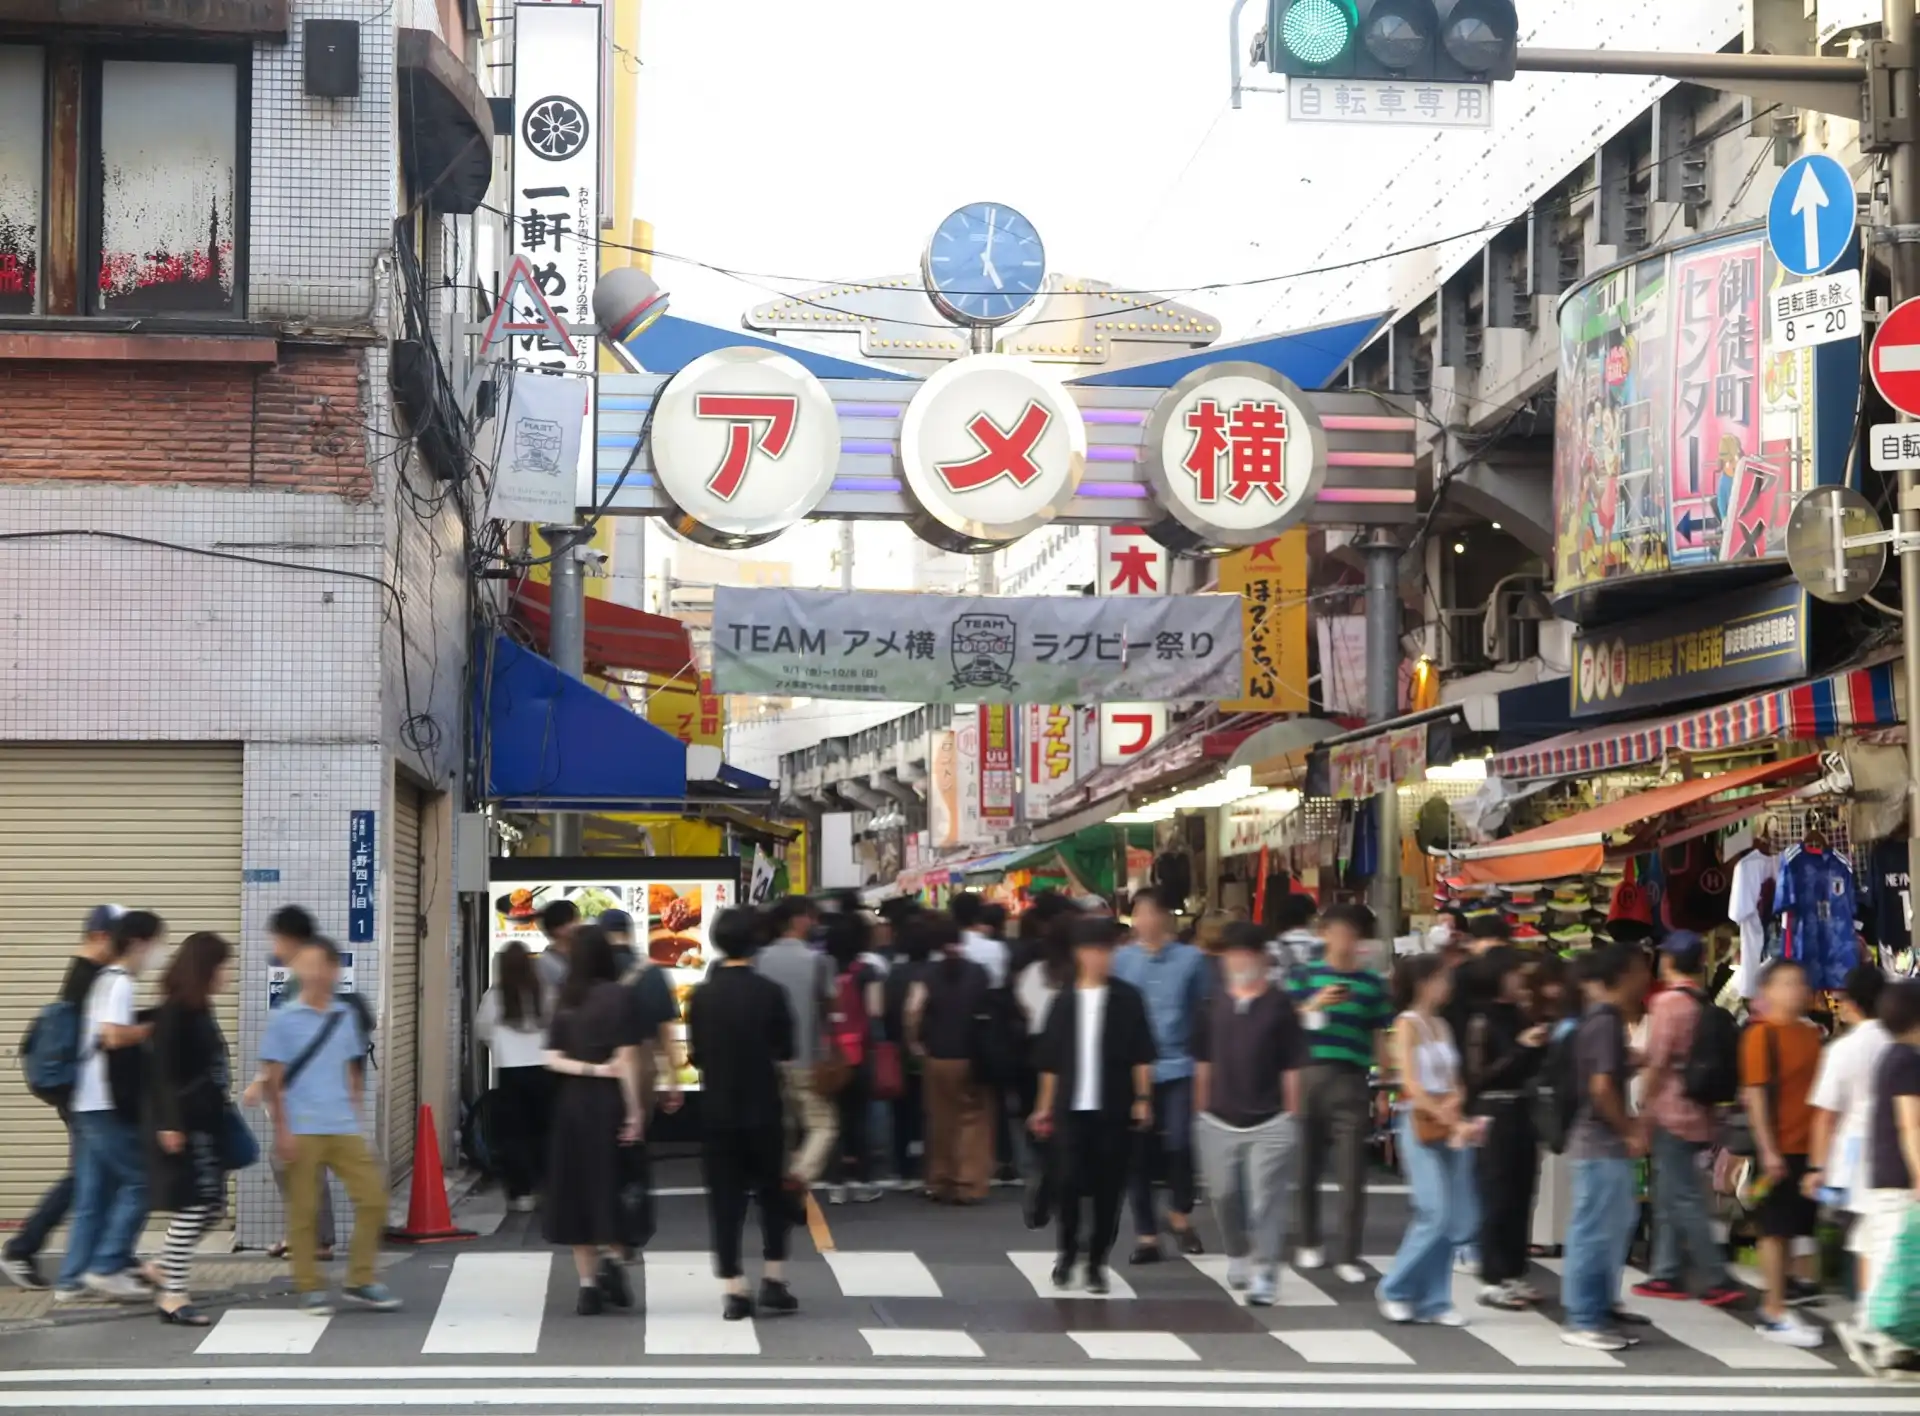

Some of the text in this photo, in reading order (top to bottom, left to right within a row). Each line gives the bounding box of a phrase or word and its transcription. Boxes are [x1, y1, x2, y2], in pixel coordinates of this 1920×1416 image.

[1299, 83, 1483, 119] 自転車専用
[1777, 282, 1853, 317] 自転車を除く
[1714, 256, 1755, 425] 御徒町
[1677, 268, 1713, 494] センター
[728, 624, 1215, 661] TEAM アメ横 ラグビー祭り
[965, 620, 1004, 630] TEAM
[1245, 579, 1278, 699] ほていちゃん
[356, 841, 368, 934] 上野四丁目 1
